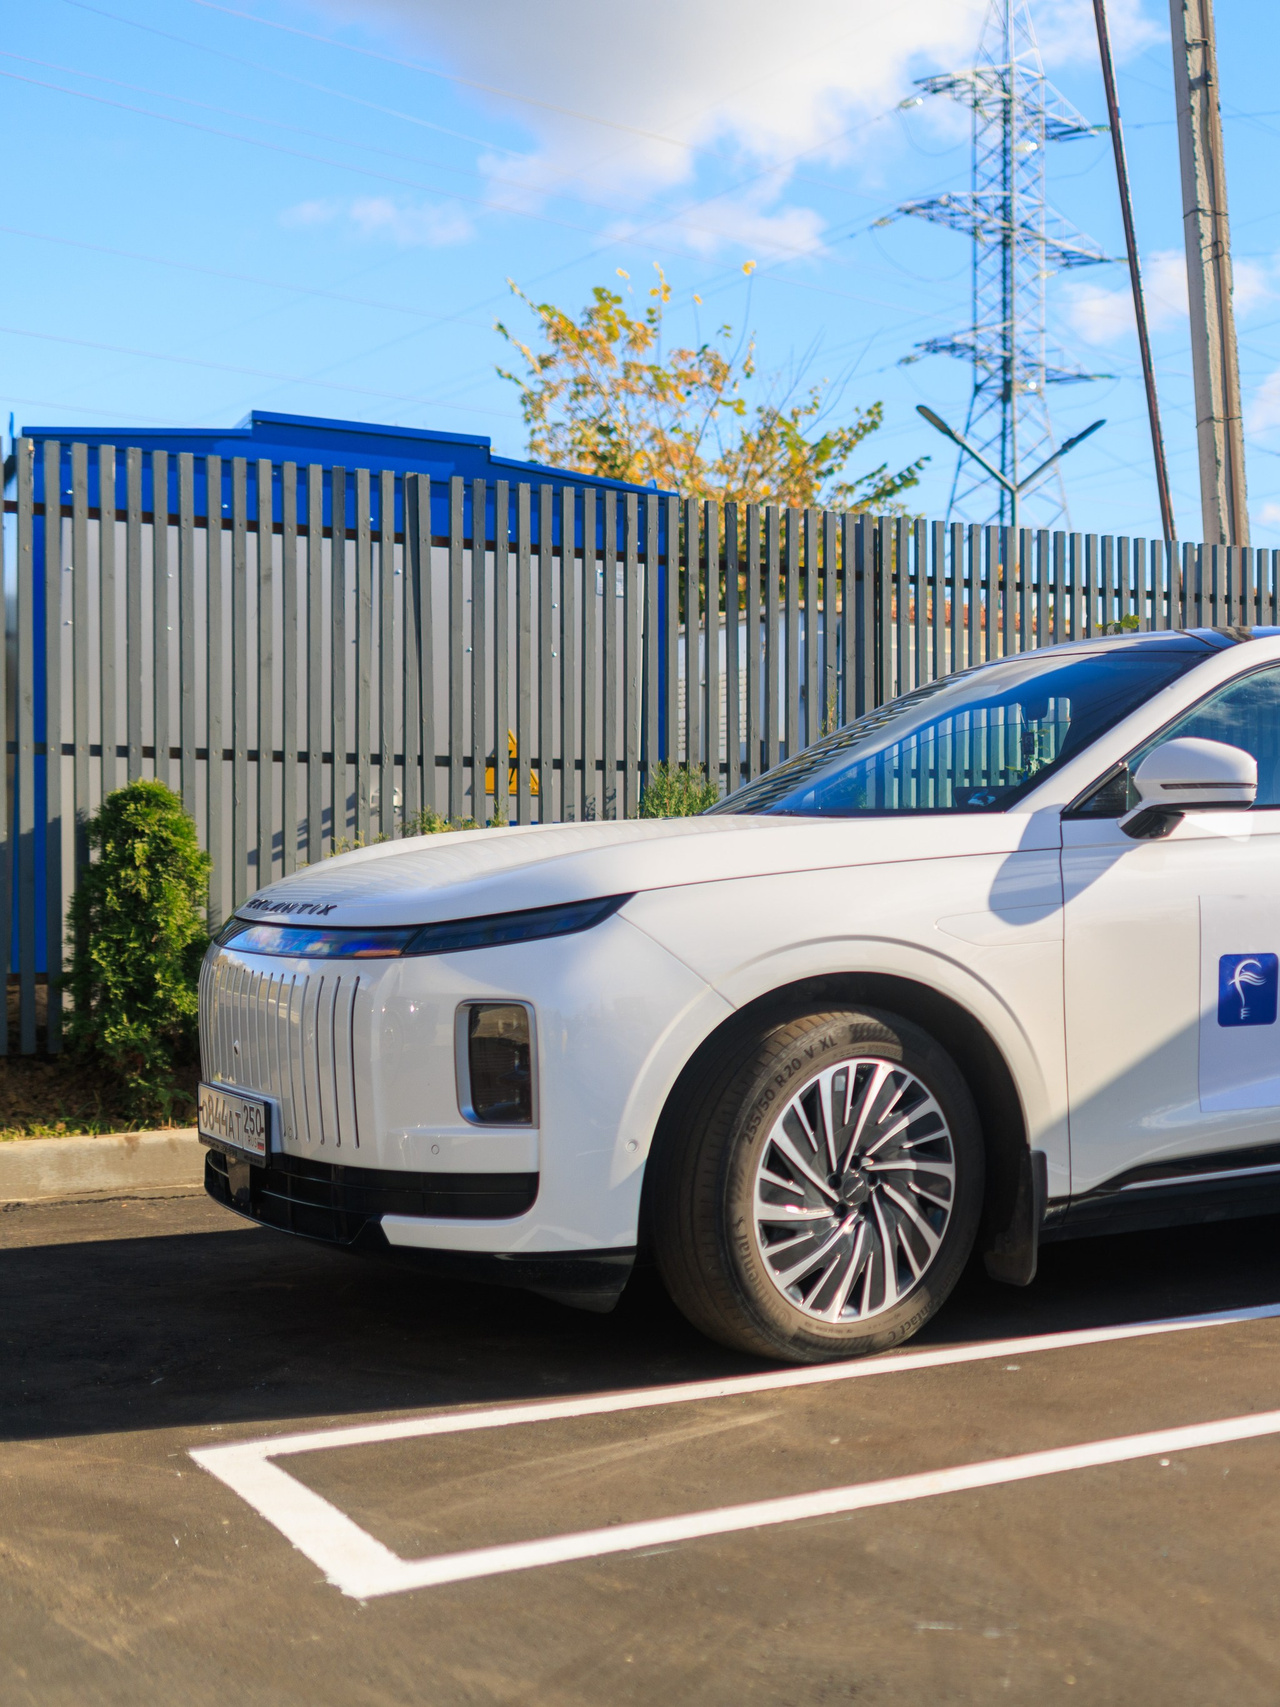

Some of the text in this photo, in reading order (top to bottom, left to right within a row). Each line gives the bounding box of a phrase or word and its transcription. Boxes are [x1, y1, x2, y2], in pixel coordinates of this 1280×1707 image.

[243, 1104, 262, 1138] 250
[742, 1088, 775, 1144] 255/50
[803, 1044, 815, 1060] V
[819, 1035, 838, 1052] XL
